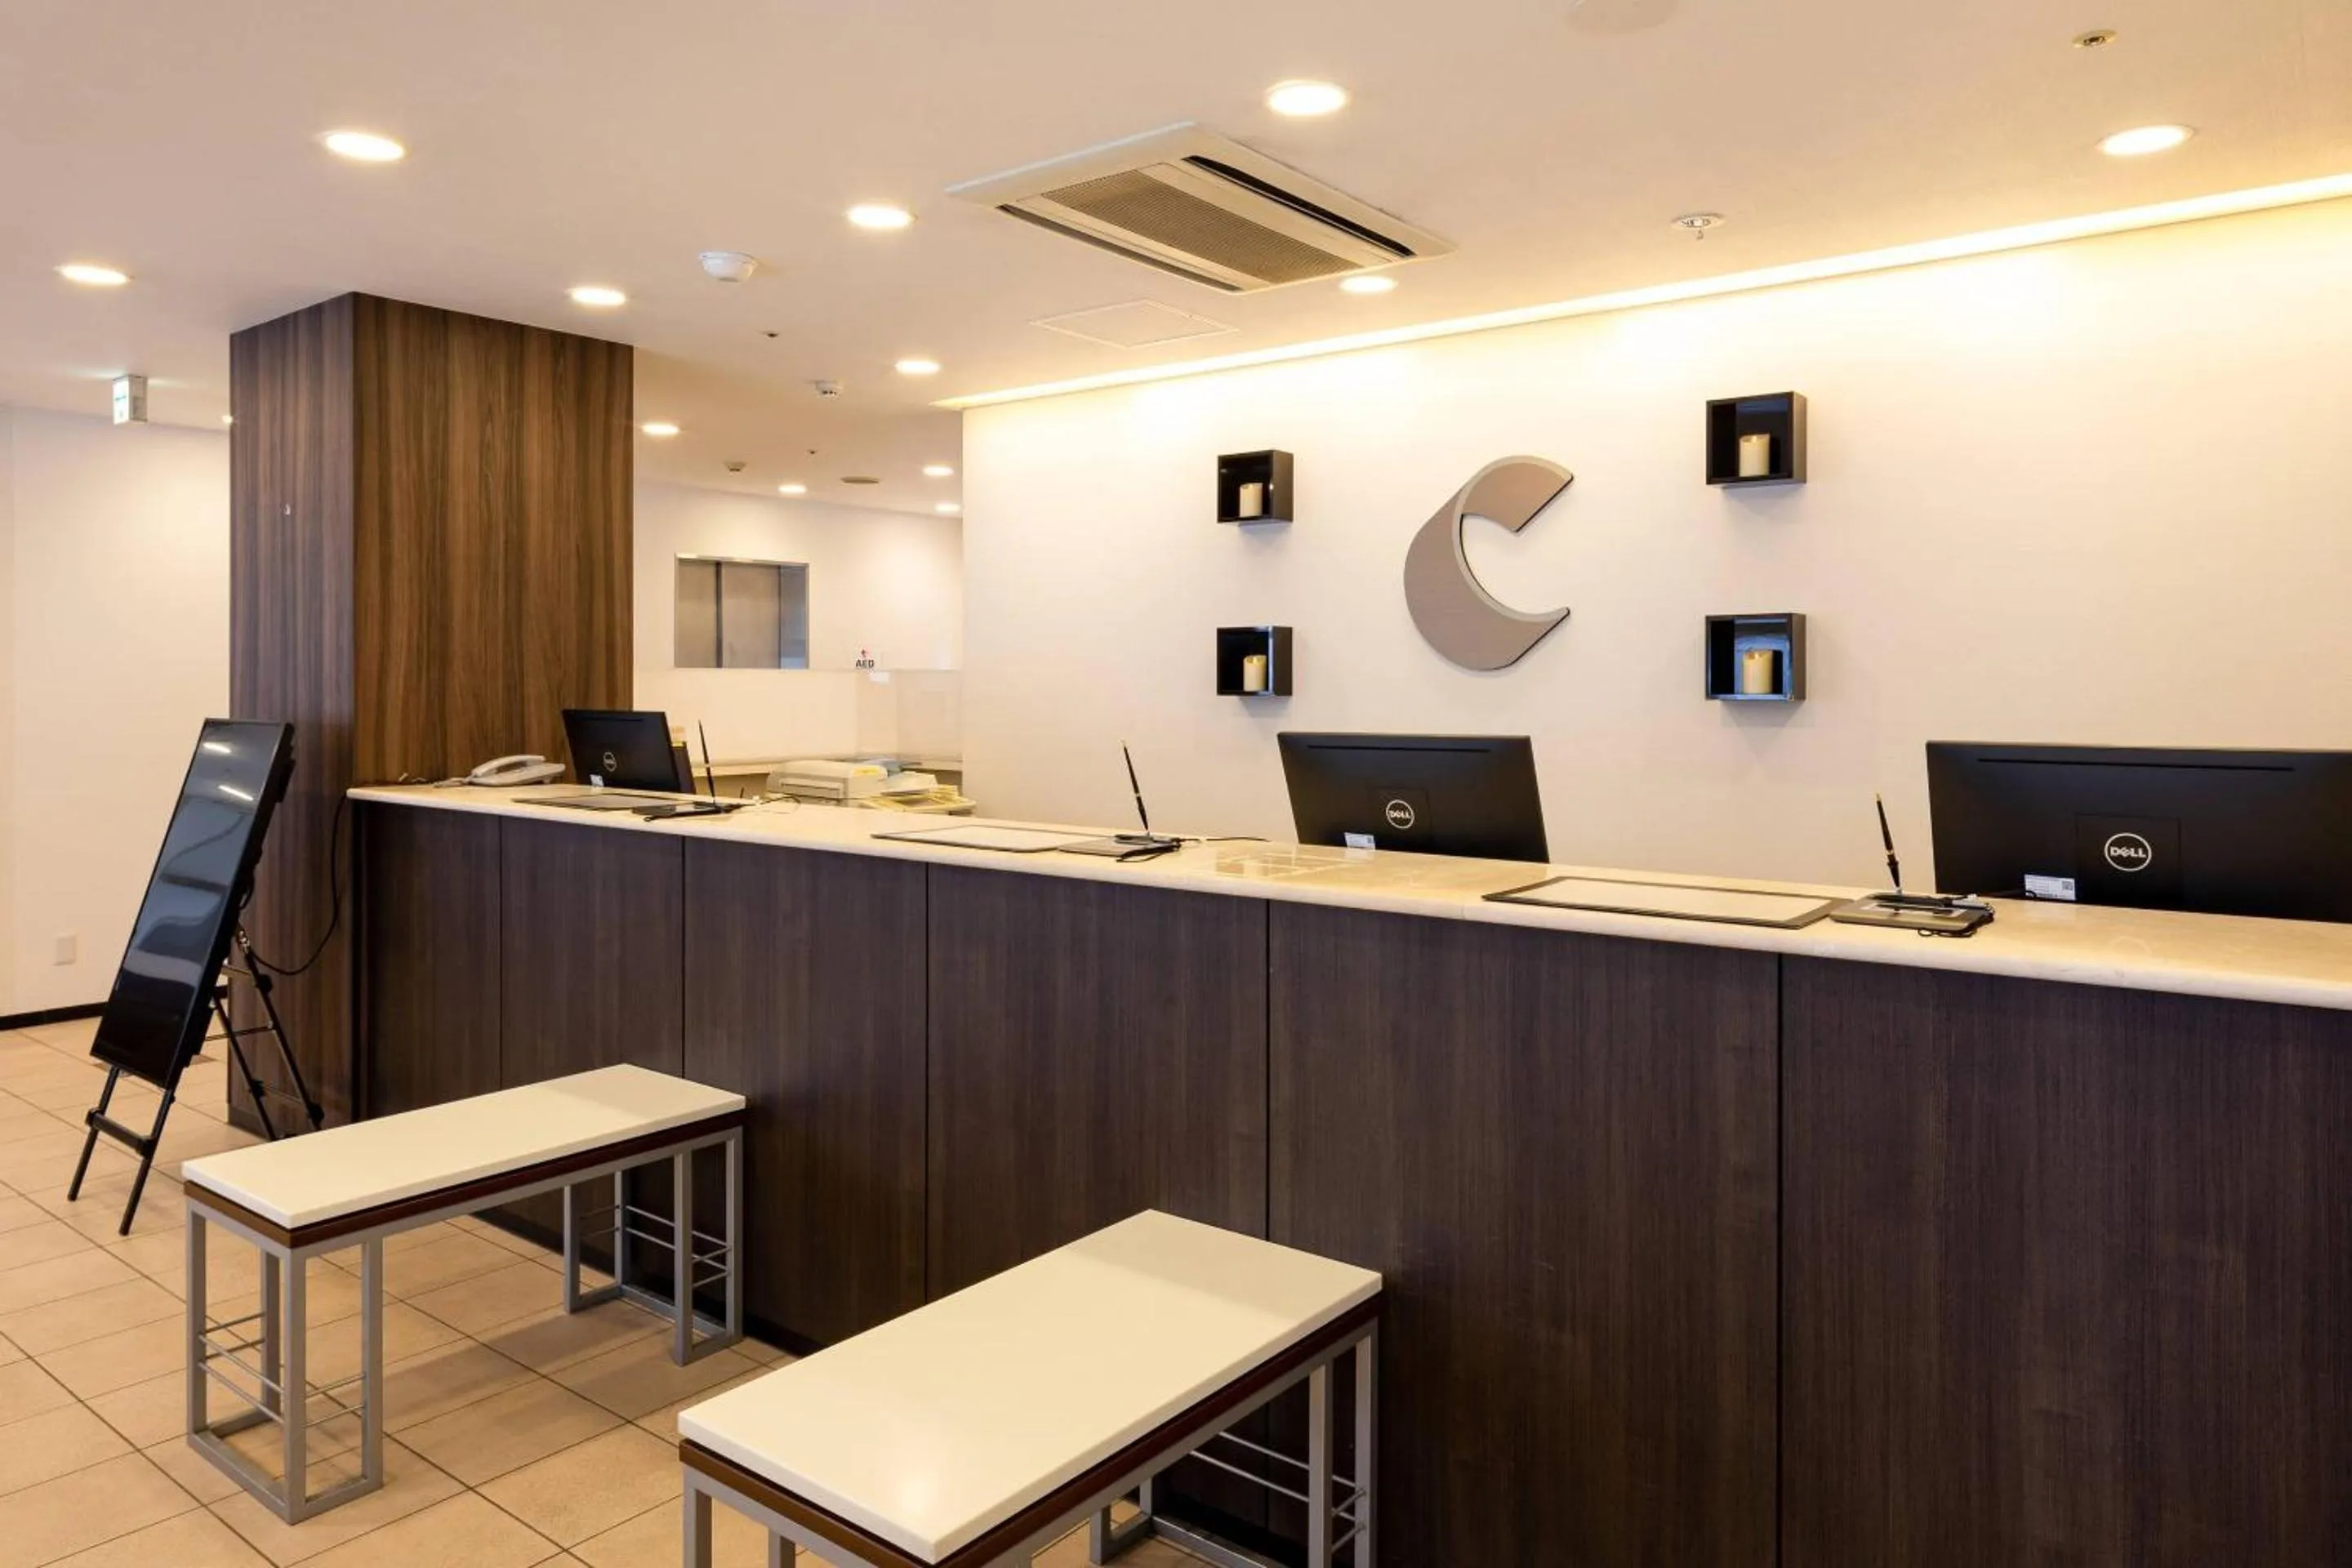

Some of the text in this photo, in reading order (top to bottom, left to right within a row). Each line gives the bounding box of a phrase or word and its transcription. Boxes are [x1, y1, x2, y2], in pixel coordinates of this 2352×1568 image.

[855, 659, 875, 667] AED
[1388, 809, 1412, 819] DELL
[2109, 846, 2147, 858] DELL
